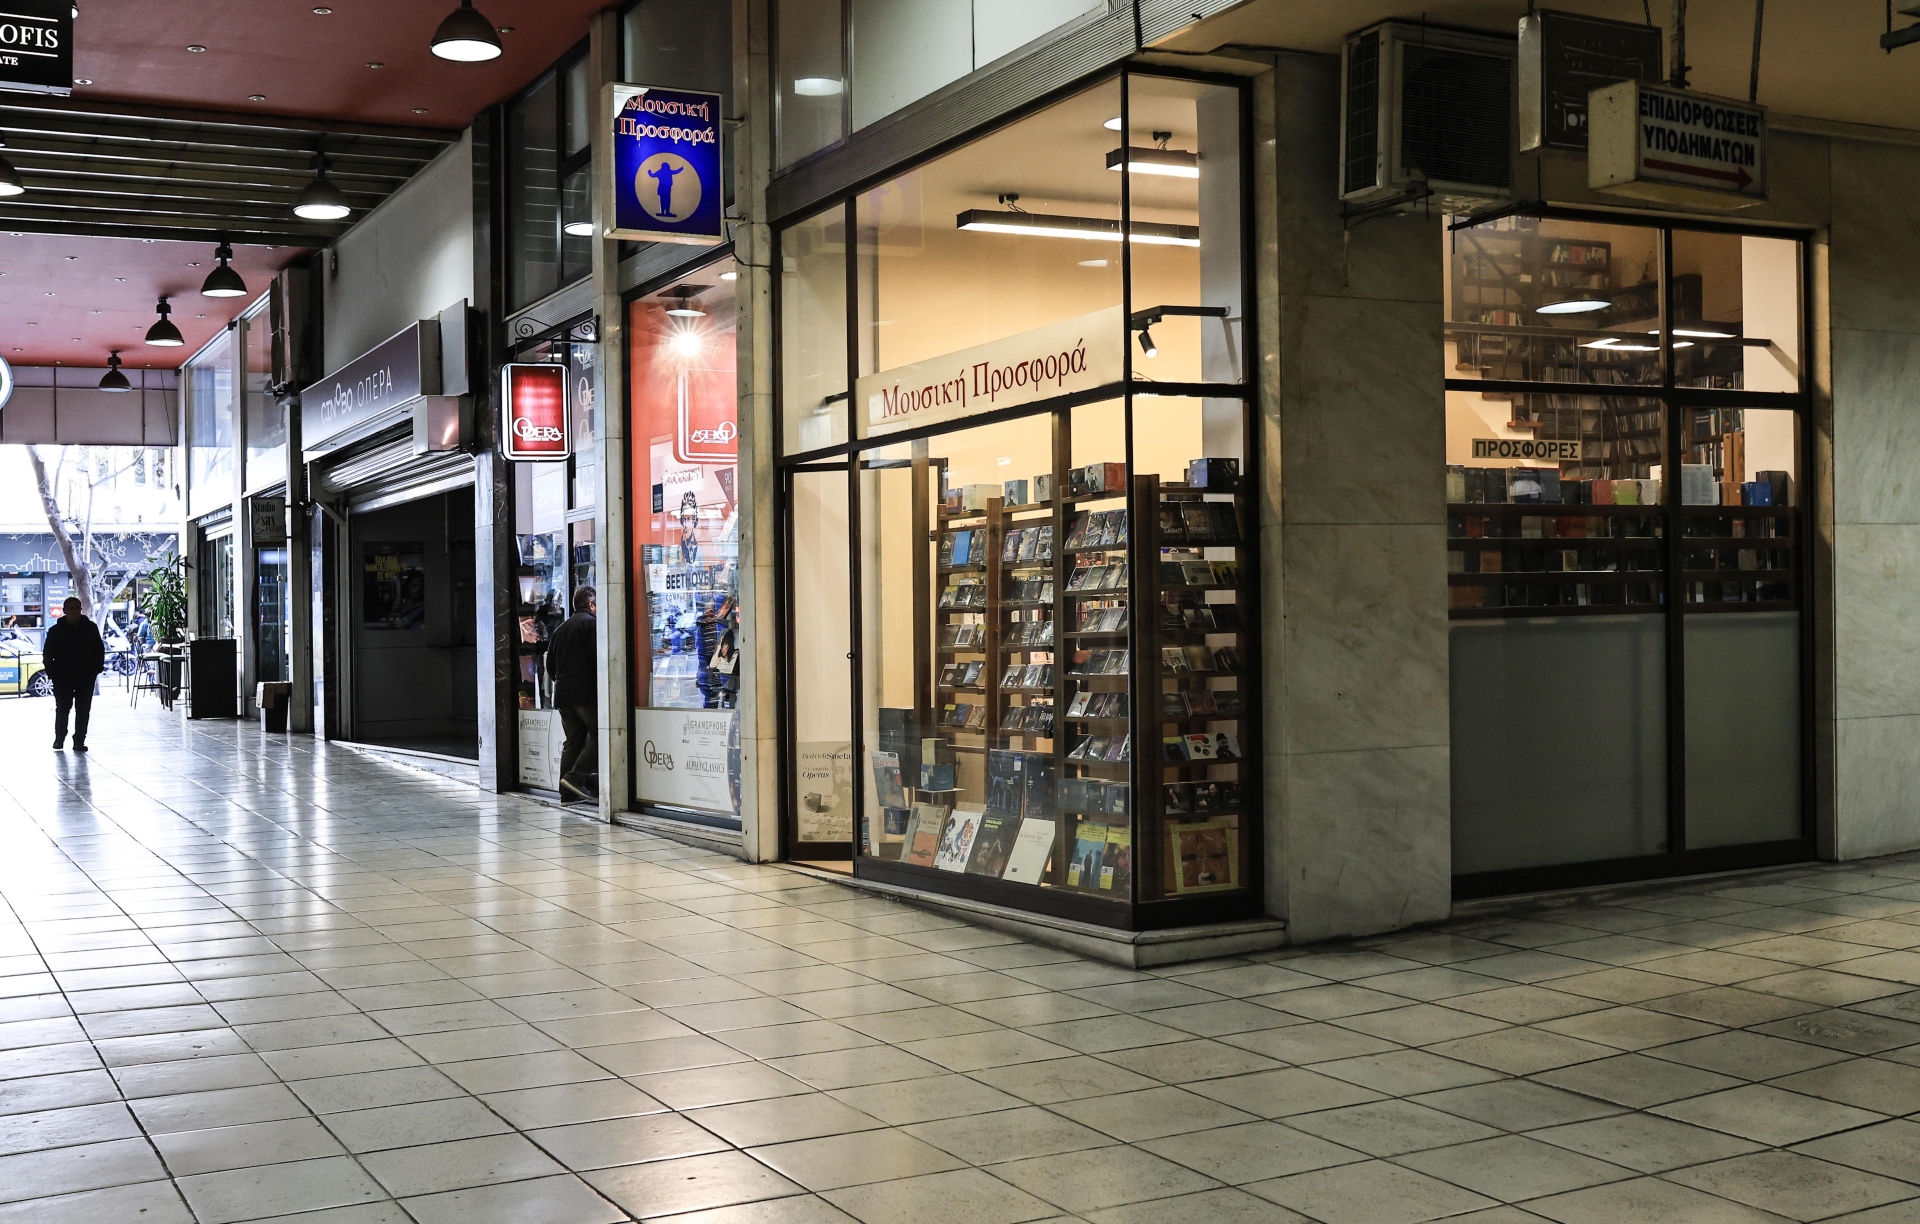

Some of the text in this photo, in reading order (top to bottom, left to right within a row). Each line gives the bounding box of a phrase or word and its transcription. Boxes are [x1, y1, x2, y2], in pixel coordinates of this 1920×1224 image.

[625, 95, 709, 122] Μουσική
[1639, 92, 1760, 138] ΕΠΙΔΙΟΡΘΩΣΕΙΣ
[619, 117, 716, 146] Προσφορά
[1643, 124, 1755, 167] ΥΠΟΔΗΜΑΤΩΝ
[881, 338, 1087, 419] Μουσική Προσφορά
[320, 365, 393, 425] CINOBO ΟΠΕΡΑ
[513, 417, 564, 442] OPERA
[1475, 440, 1579, 459] ΠΡΟΣΦΟΡΕΣ
[253, 501, 276, 513] Studio
[666, 569, 716, 590] BEETHOVEN
[643, 739, 675, 771] OPERA
[802, 770, 830, 780] Operas
